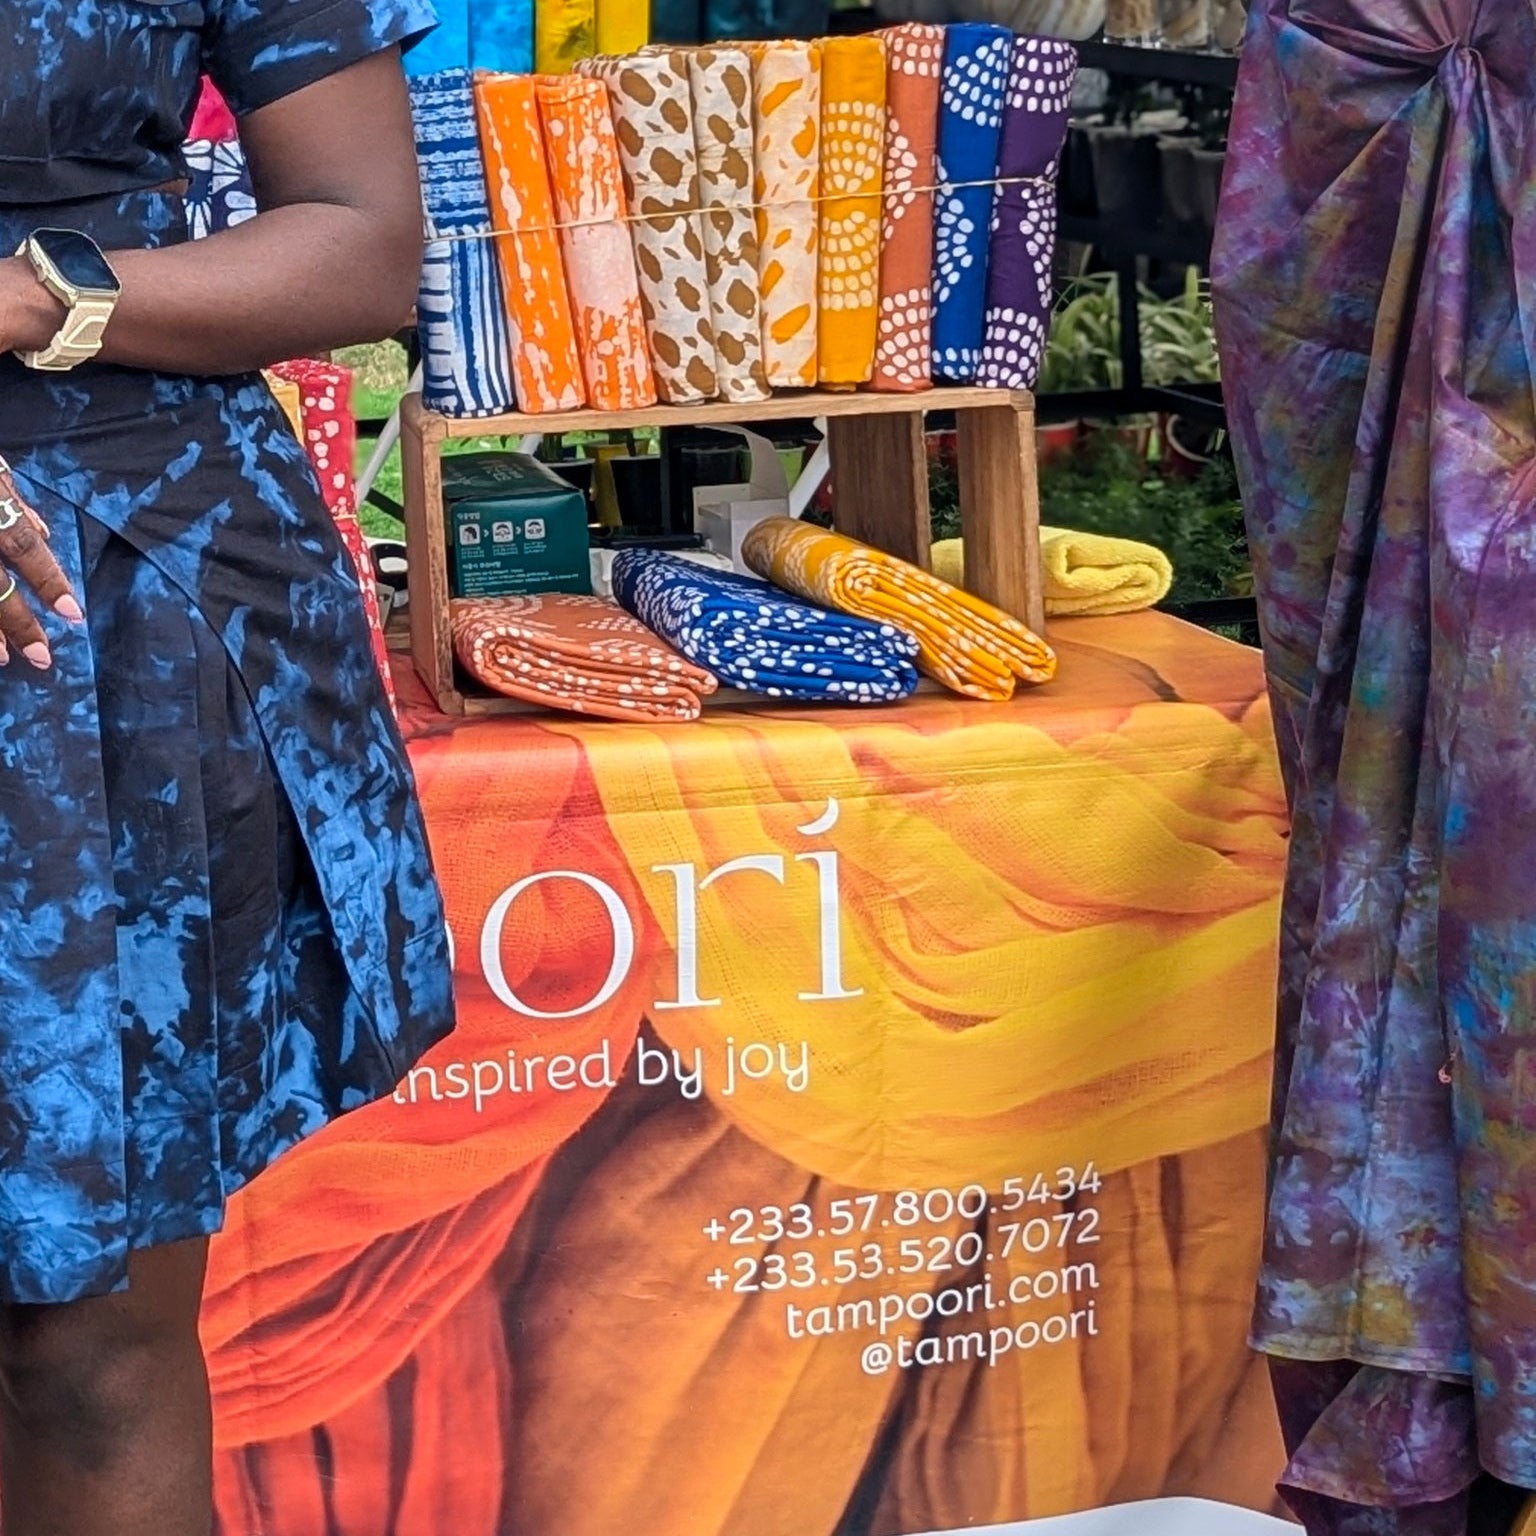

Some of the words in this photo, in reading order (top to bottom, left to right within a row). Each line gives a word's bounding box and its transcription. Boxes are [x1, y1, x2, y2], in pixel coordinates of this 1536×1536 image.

[445, 797, 864, 1019] ori
[637, 1036, 703, 1100] by
[724, 1035, 810, 1094] joy
[702, 1161, 1102, 1245] +233.57.800.5434
[706, 1208, 1101, 1293] +233.53.520.7072
[786, 1262, 1100, 1339] tampoori.com
[860, 1300, 1098, 1375] @tampoori
